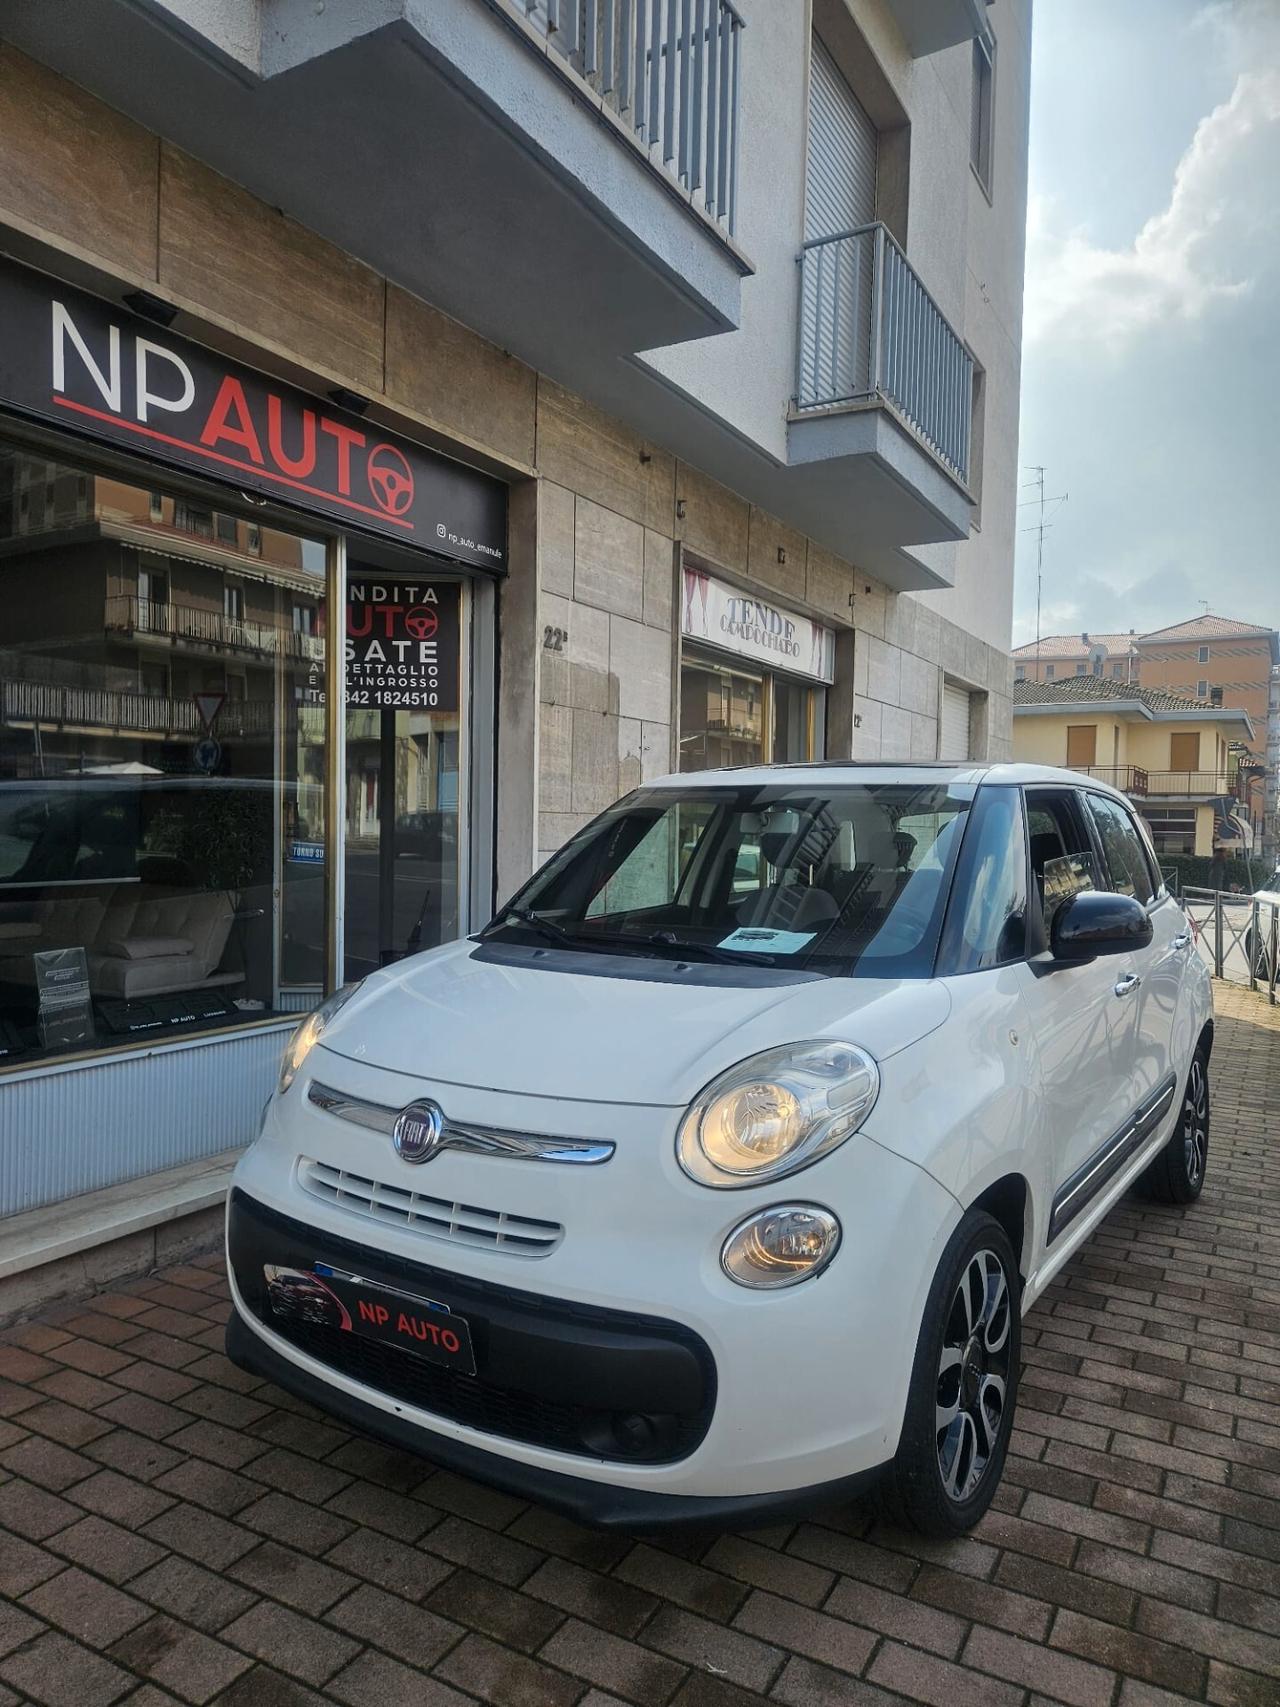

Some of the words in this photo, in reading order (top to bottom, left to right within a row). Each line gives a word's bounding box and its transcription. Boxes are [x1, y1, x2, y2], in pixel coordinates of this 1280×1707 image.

[350, 585, 439, 604] NDITA
[727, 597, 796, 641] TENDE
[374, 692, 438, 706] 1824510
[402, 1119, 428, 1145] FIAT
[358, 1299, 390, 1327] NP
[397, 1312, 461, 1353] AUTO
